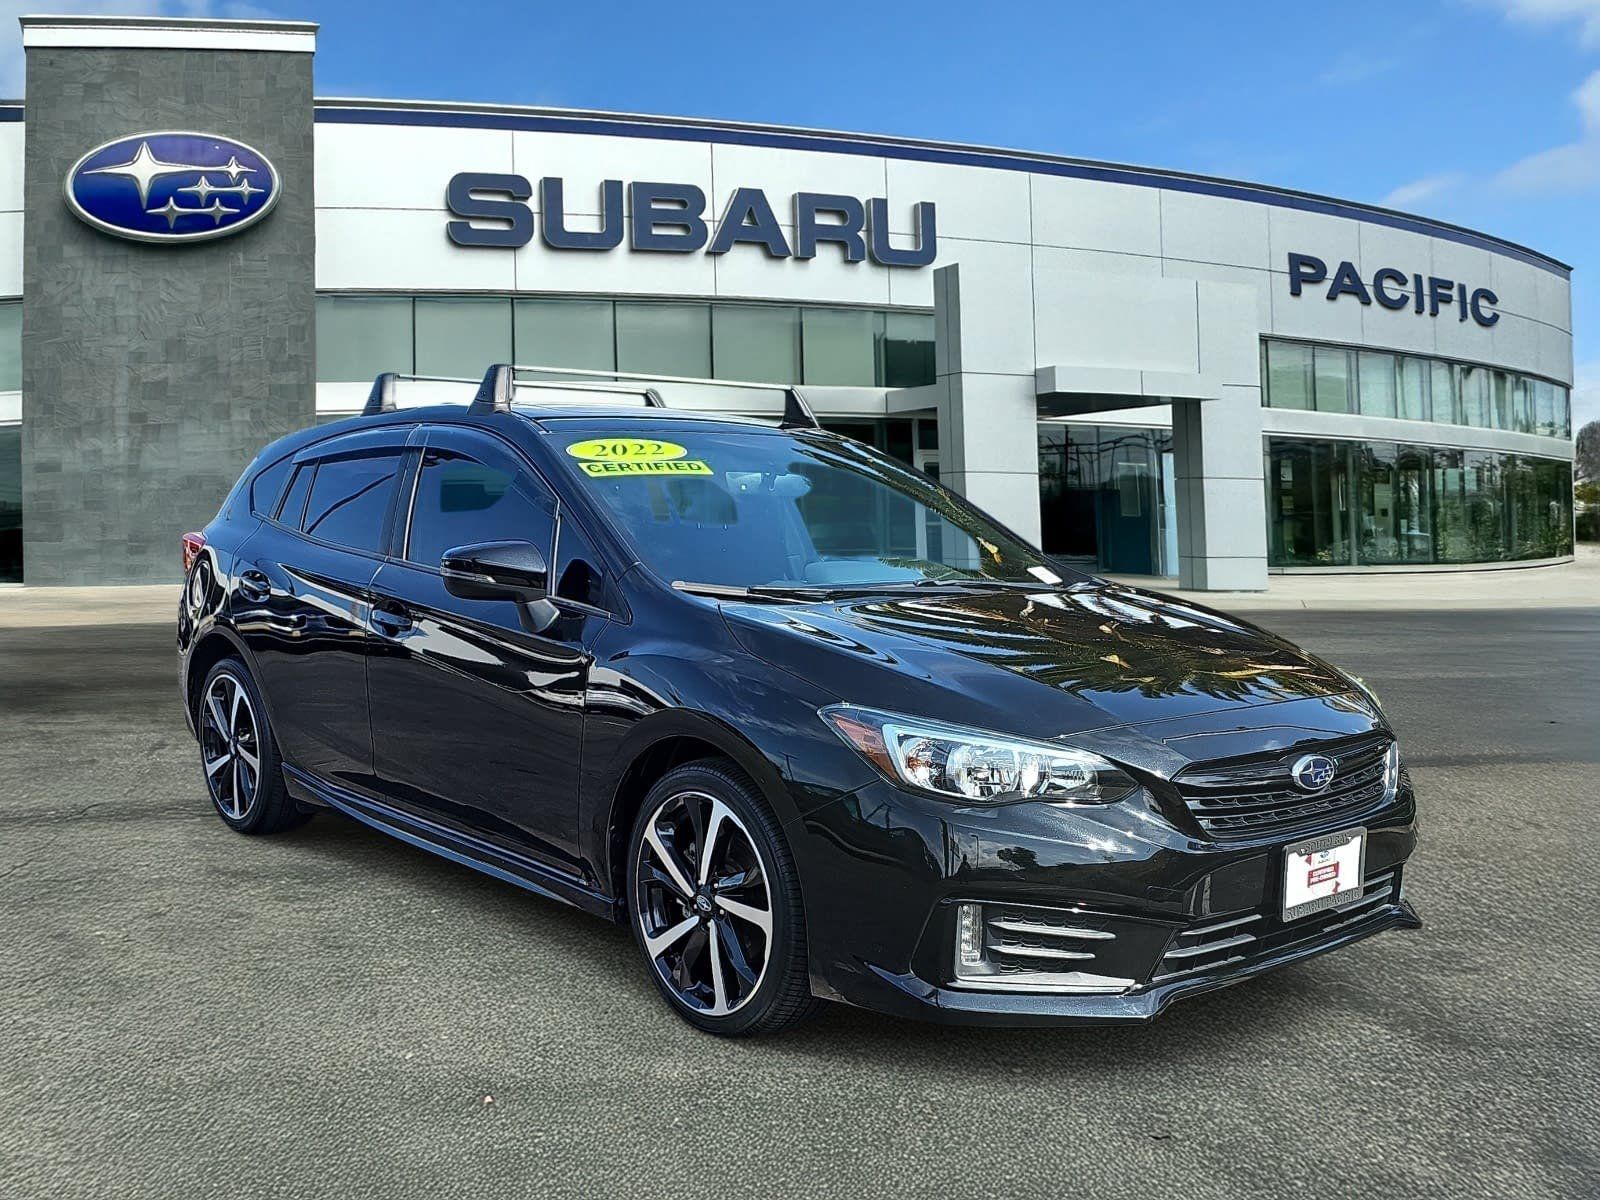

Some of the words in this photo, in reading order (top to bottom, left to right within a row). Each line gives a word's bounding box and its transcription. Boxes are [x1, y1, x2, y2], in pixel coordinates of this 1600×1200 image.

[446, 171, 937, 267] SUBARU
[1288, 252, 1500, 327] PACIFIC
[586, 462, 702, 473] CERTIFIED
[594, 443, 664, 457] 2022
